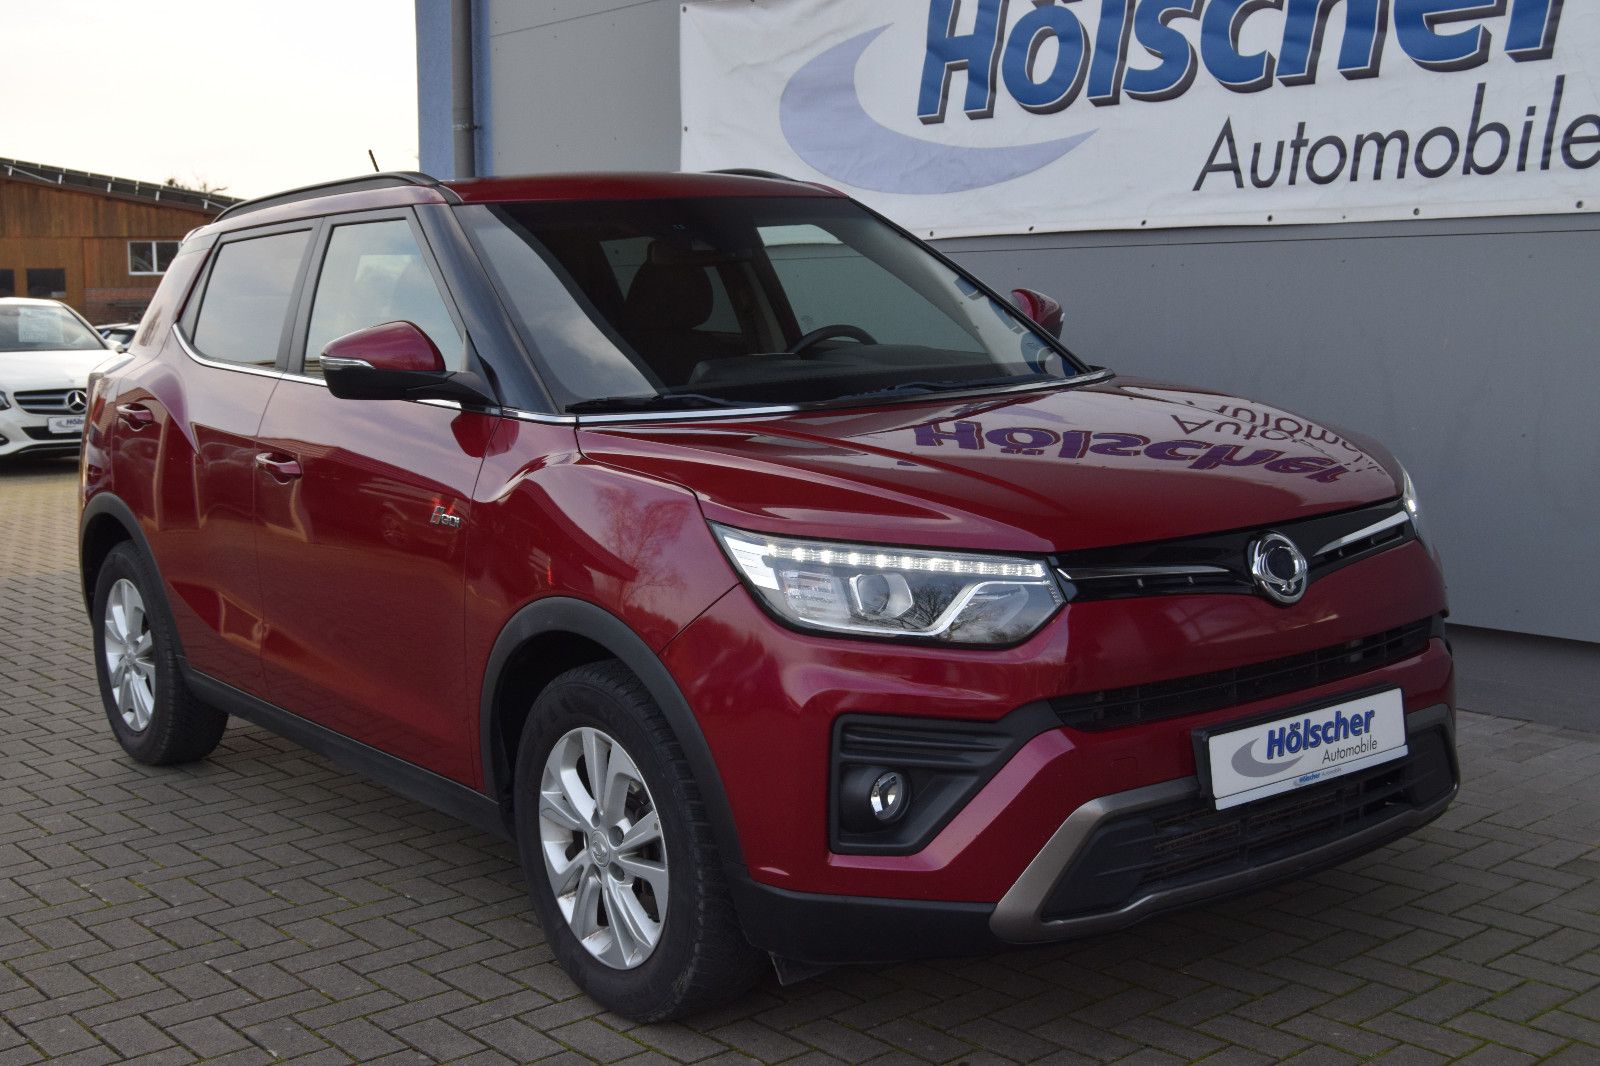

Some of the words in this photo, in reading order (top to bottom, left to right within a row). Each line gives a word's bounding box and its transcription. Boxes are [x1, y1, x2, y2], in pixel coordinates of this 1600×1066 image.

[1192, 74, 1600, 191] Automobile
[1267, 710, 1375, 760] Hölscher
[1322, 736, 1377, 764] Automobile
